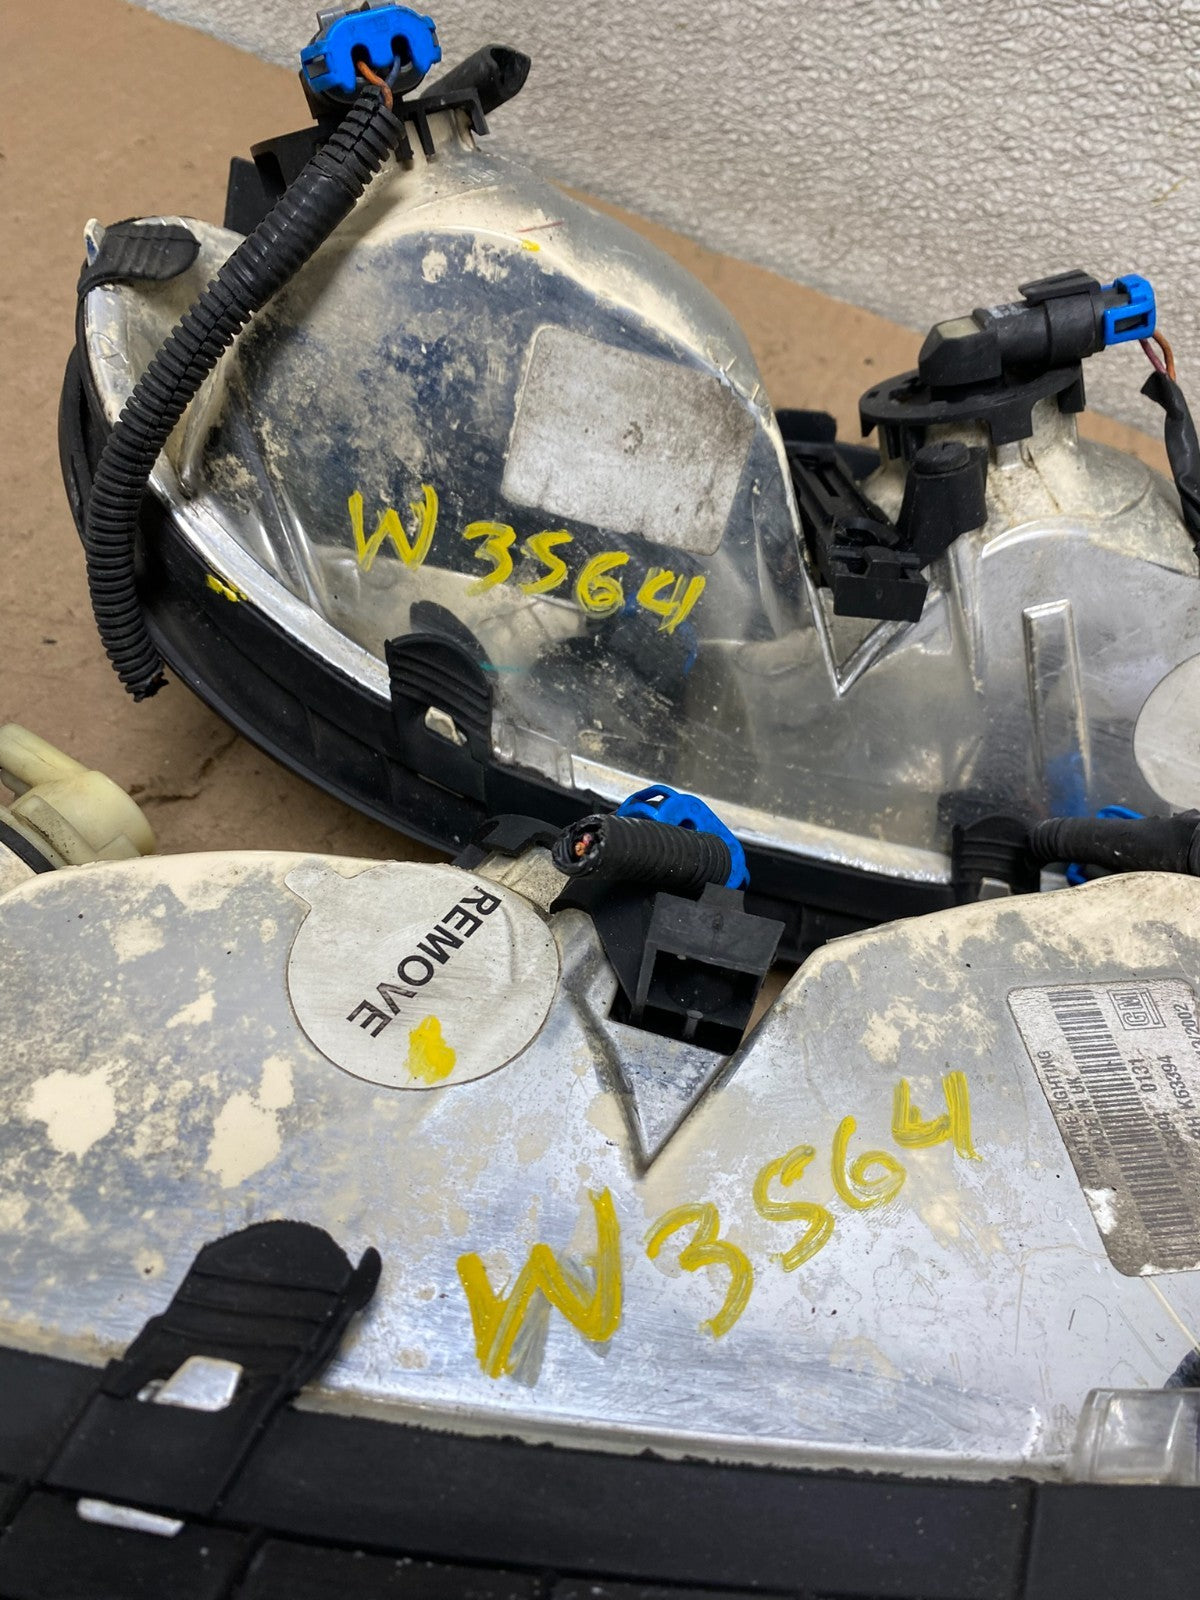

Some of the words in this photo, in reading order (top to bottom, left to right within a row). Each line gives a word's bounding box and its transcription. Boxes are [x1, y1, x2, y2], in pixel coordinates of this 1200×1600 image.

[346, 885, 502, 1038] REMOVE
[1037, 1050, 1074, 1111] LIGHTING
[1066, 1077, 1085, 1095] UK
[1128, 1058, 1157, 1093] 0131
[1157, 1055, 1195, 1109] K63394
[1074, 1099, 1094, 1113] IN
[1084, 1118, 1112, 1158] MADE
